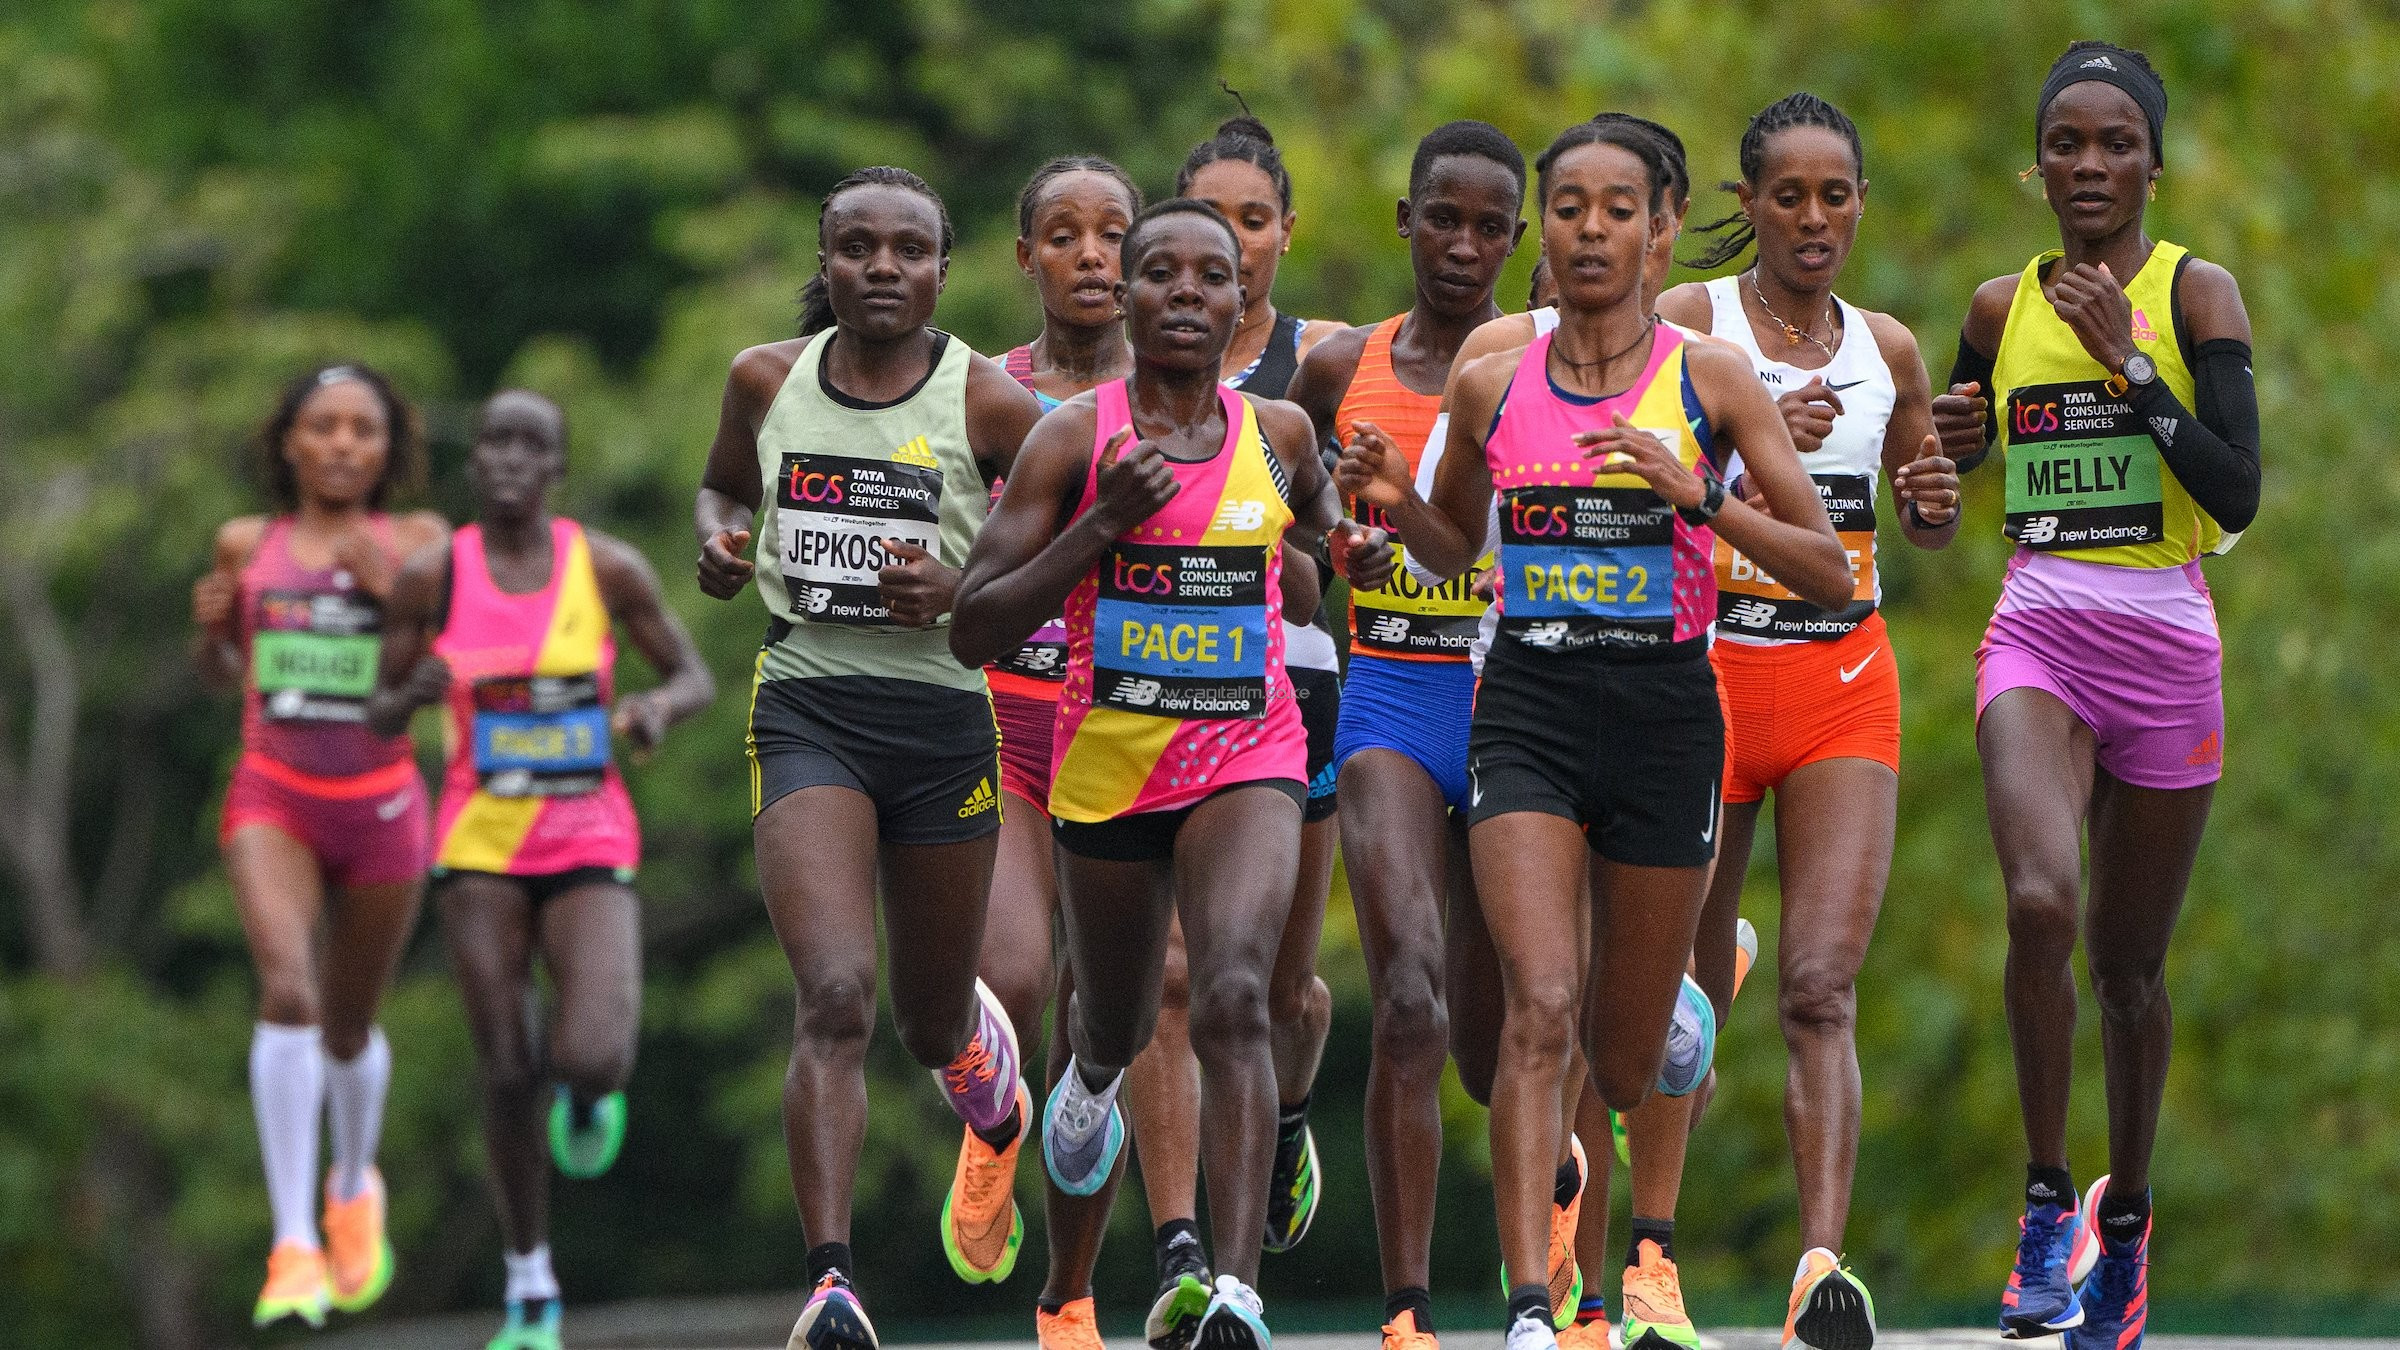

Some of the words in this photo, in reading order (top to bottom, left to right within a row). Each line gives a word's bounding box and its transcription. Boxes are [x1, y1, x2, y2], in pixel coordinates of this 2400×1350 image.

[2063, 392, 2096, 405] TATA
[2016, 398, 2059, 435] tcs
[2064, 403, 2134, 418] CONSULTAN
[2064, 418, 2115, 431] SERVICES
[2148, 416, 2174, 447] adidas
[891, 452, 939, 469] adidas
[852, 468, 886, 483] TATA
[2027, 454, 2133, 497] MELLY
[790, 463, 845, 504] tcs
[850, 482, 931, 501] CONSULTANCY
[848, 495, 900, 510] SERVICES
[1575, 498, 1613, 511] TATA
[1511, 496, 1568, 537] tcs
[1575, 512, 1663, 526] CONSULTANCY
[1574, 526, 1631, 540] SERVICES
[2060, 530, 2087, 542] new
[2090, 525, 2148, 540] balance
[1179, 557, 1217, 569] TATA
[1114, 553, 1173, 595] tcs
[1179, 571, 1257, 583] CONSULTANCY
[1179, 585, 1233, 597] SERVICES
[1524, 563, 1619, 604] PACE
[1626, 565, 1649, 604] 2
[831, 604, 860, 617] new
[1774, 620, 1802, 632] new
[1805, 619, 1858, 633] balance
[1121, 620, 1219, 663] PACE
[1228, 626, 1244, 662] 1
[1410, 635, 1437, 646] new
[1440, 635, 1478, 648] balan
[1566, 634, 1595, 647] new
[1598, 627, 1659, 645] balance
[1160, 698, 1190, 710] new
[1193, 698, 1250, 712] balance
[957, 795, 996, 818] adidas
